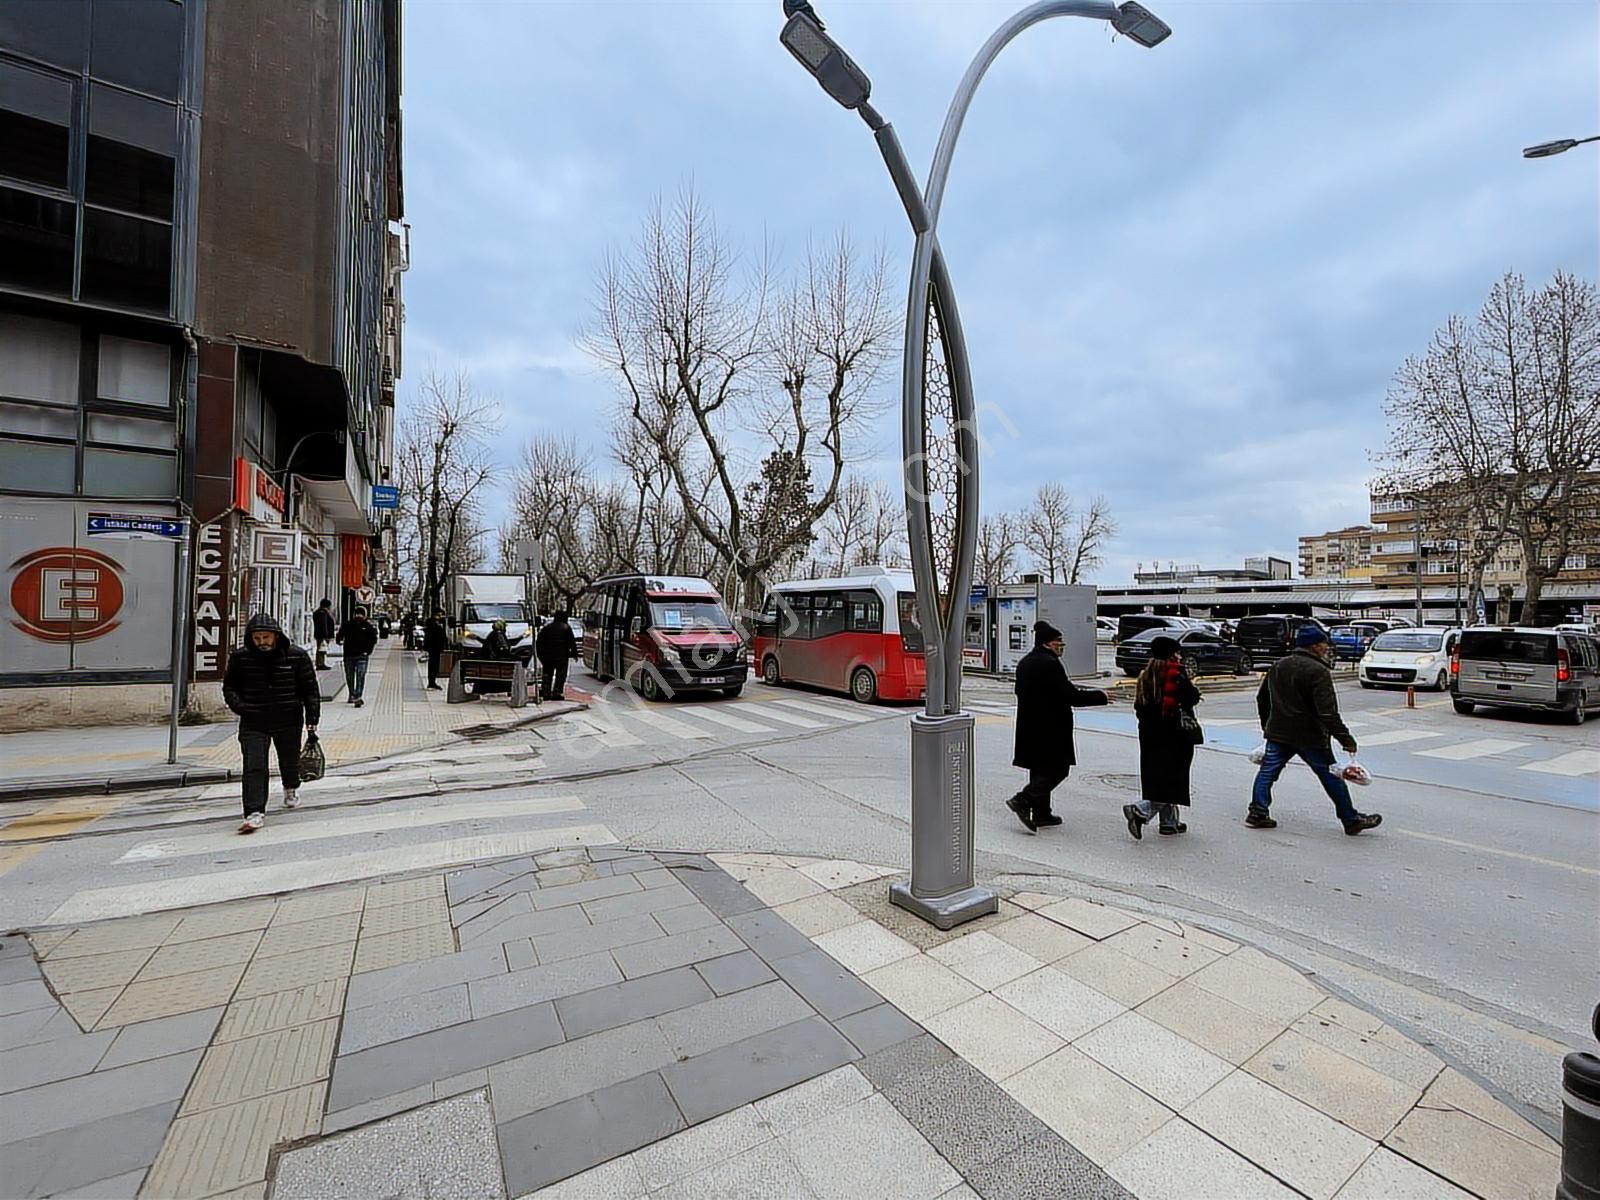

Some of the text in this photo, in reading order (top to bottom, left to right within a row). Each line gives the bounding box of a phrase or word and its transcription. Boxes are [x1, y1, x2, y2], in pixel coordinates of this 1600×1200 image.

[263, 536, 288, 561] E
[40, 567, 99, 621] E
[194, 524, 221, 671] ECZANE
